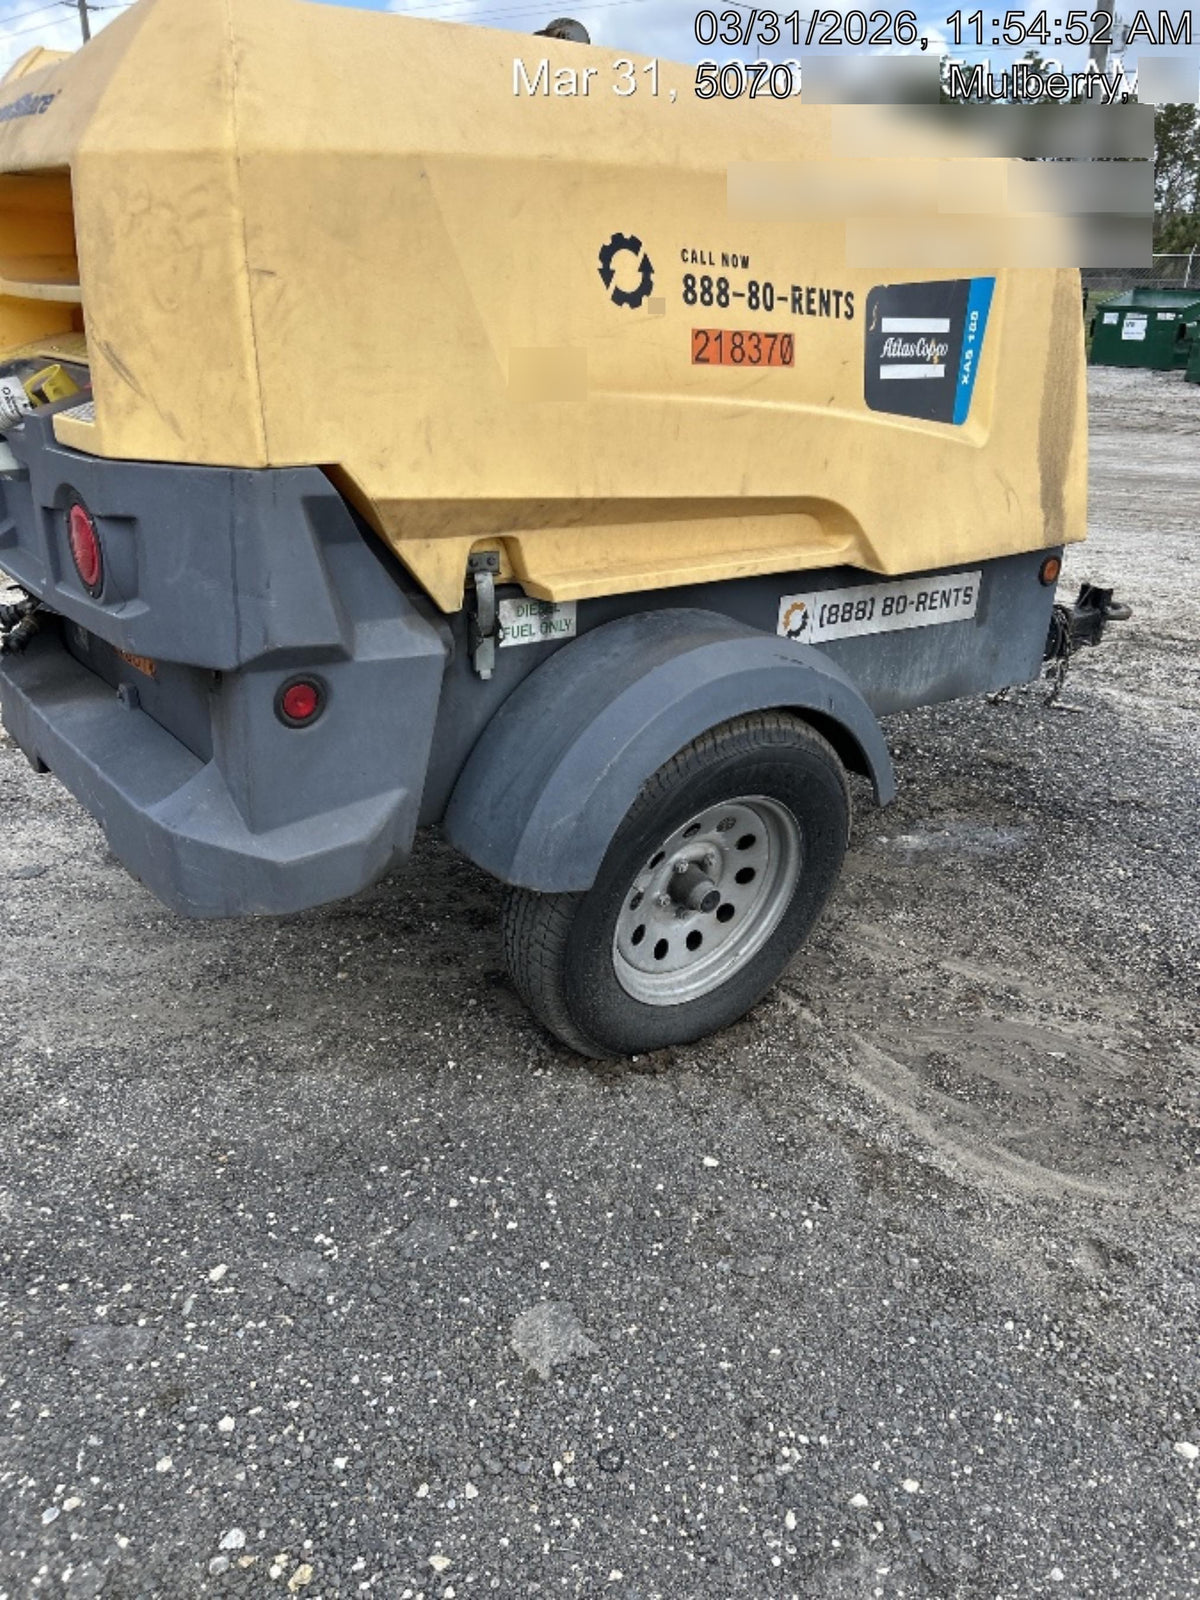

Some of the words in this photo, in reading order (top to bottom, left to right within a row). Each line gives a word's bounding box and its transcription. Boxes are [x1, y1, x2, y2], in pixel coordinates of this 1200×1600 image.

[681, 248, 715, 266] CALL
[721, 252, 750, 269] NOW
[682, 273, 855, 321] 888-80-RENTS
[694, 330, 794, 366] 218370
[819, 598, 875, 628] (888)
[881, 586, 974, 616] 80-RENTS
[503, 623, 535, 638] FUEL
[540, 617, 572, 636] ONLY
